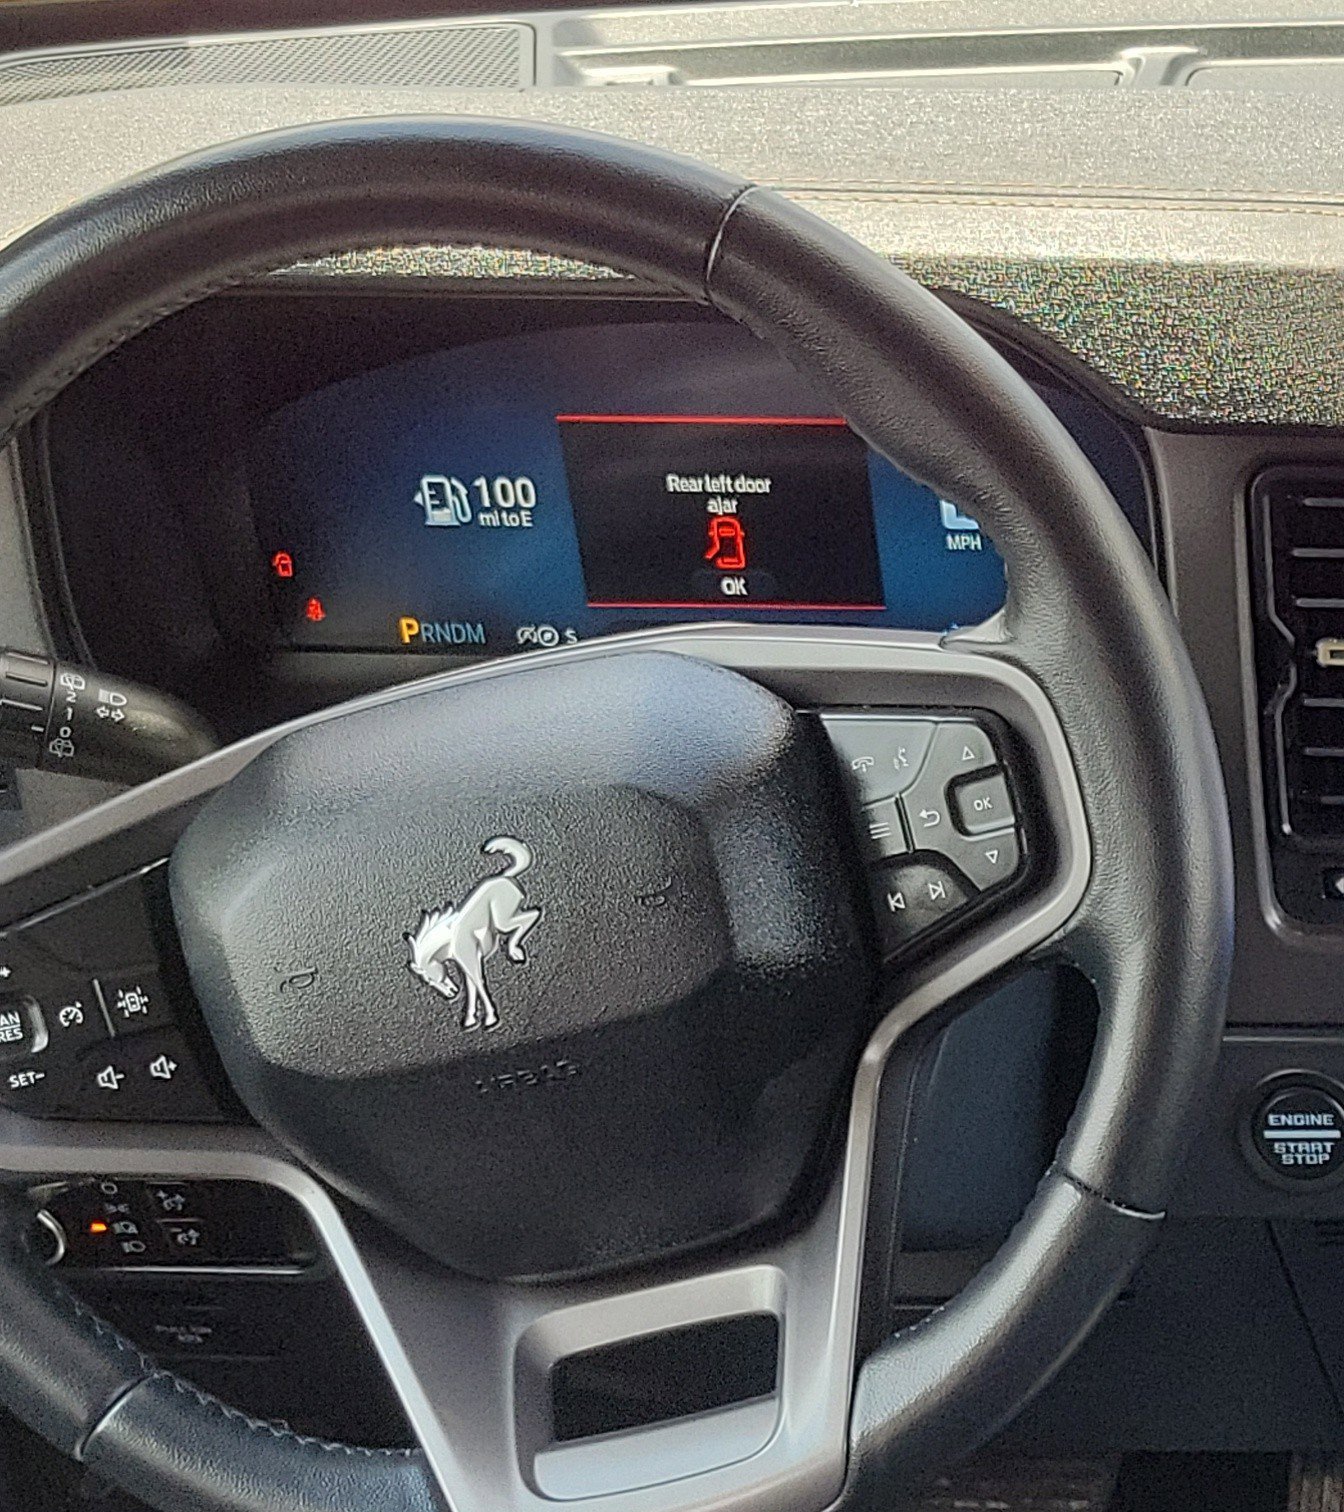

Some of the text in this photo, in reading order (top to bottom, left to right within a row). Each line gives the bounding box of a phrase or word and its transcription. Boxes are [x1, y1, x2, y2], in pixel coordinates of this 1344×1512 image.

[473, 476, 536, 508] 100
[666, 473, 771, 493] Rear left door
[706, 496, 738, 515] ajar
[501, 510, 519, 527] to
[521, 509, 533, 527] E
[946, 533, 982, 551] MPH
[721, 576, 748, 595] OK
[66, 691, 76, 703] 2
[67, 707, 73, 721] 1
[974, 793, 993, 811] OK
[1268, 1113, 1334, 1127] ENGINE
[1273, 1142, 1335, 1154] START
[1281, 1153, 1330, 1165] STOP
